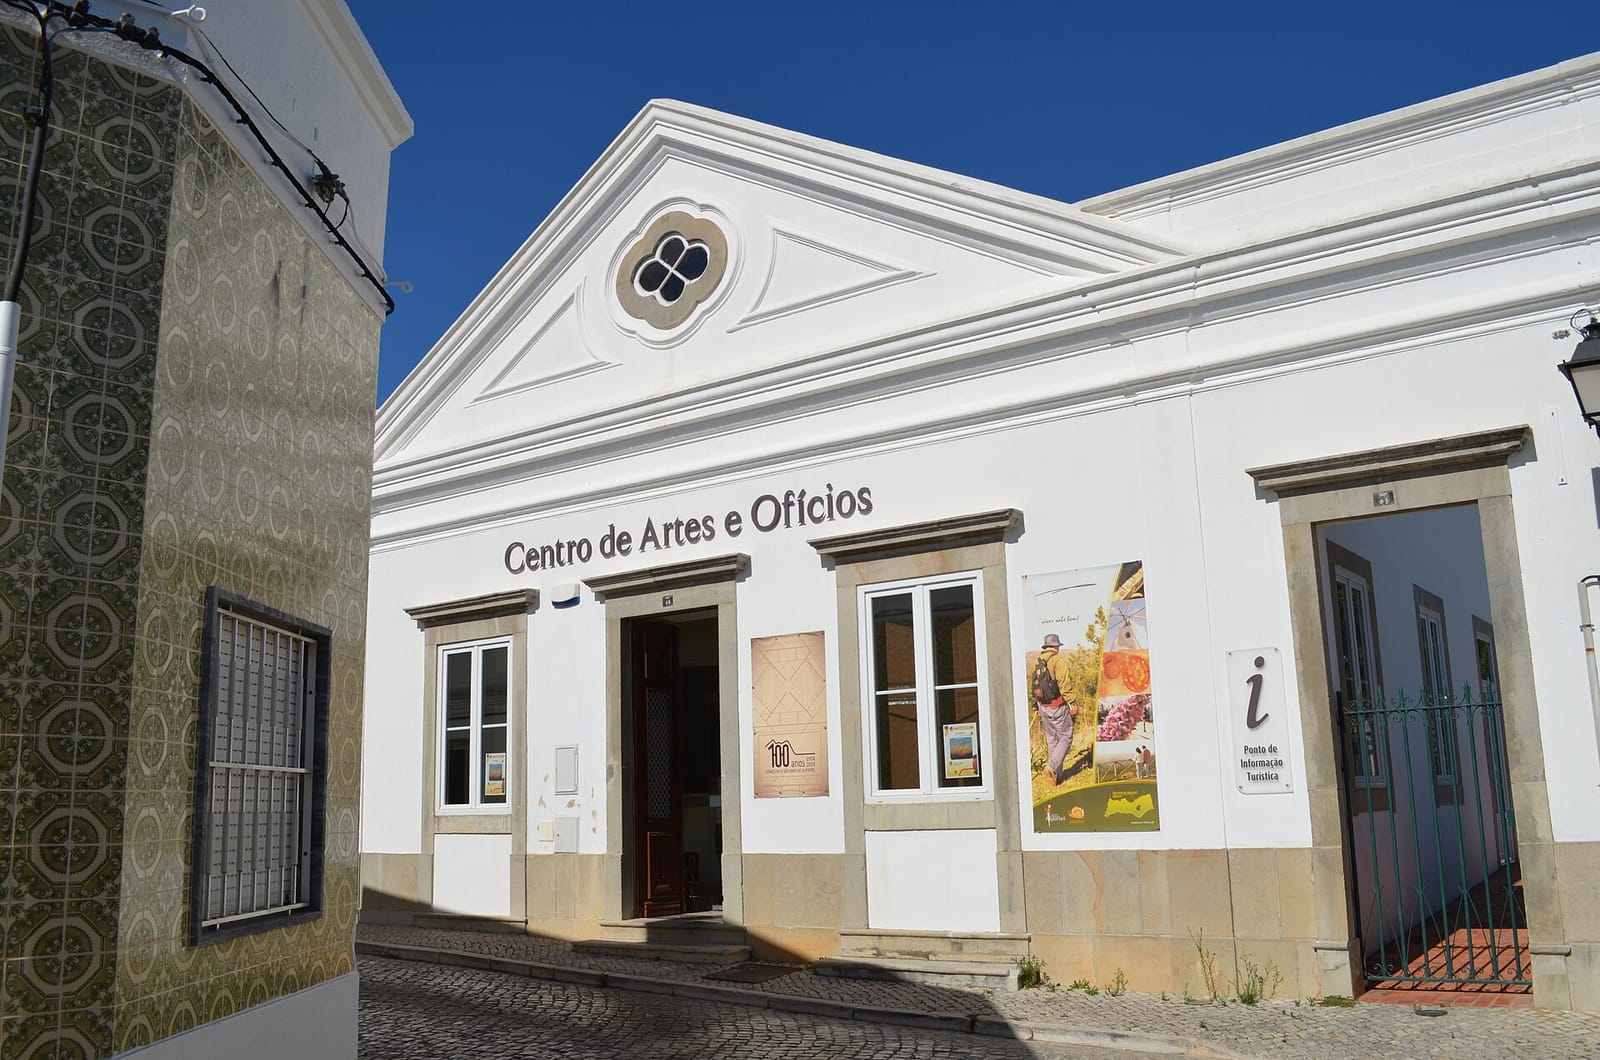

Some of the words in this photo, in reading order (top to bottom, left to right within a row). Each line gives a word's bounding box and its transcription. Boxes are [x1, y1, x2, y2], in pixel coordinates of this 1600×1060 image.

[505, 538, 592, 575] Centro
[600, 523, 632, 559] de
[639, 515, 716, 553] Artes
[725, 510, 743, 538] e
[751, 483, 873, 533] Ofícios
[1246, 656, 1269, 729] i
[768, 743, 790, 768] 100
[1243, 745, 1266, 755] Ponto
[1268, 744, 1278, 754] de
[1240, 758, 1283, 769] Informação
